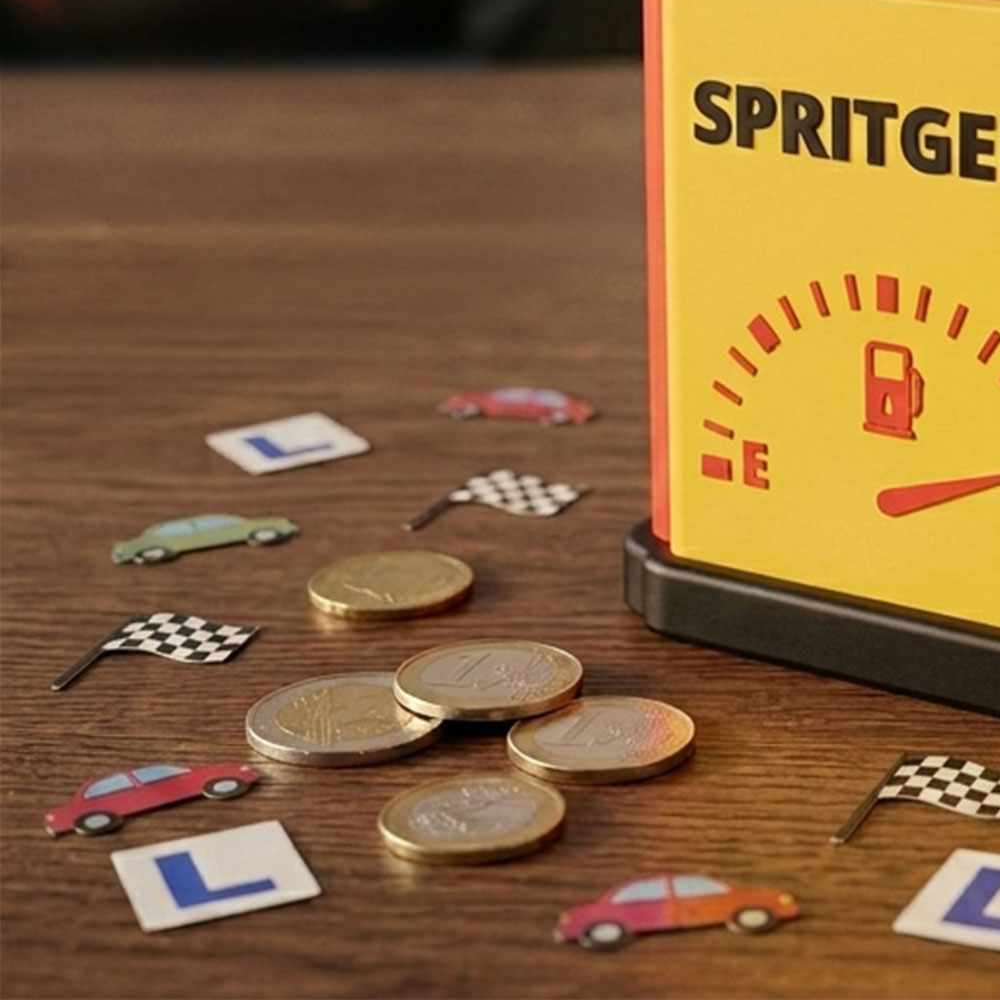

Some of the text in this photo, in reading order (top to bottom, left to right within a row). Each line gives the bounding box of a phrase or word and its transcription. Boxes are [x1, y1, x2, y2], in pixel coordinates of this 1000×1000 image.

[244, 435, 334, 459] L
[743, 440, 770, 490] E
[155, 851, 276, 909] L
